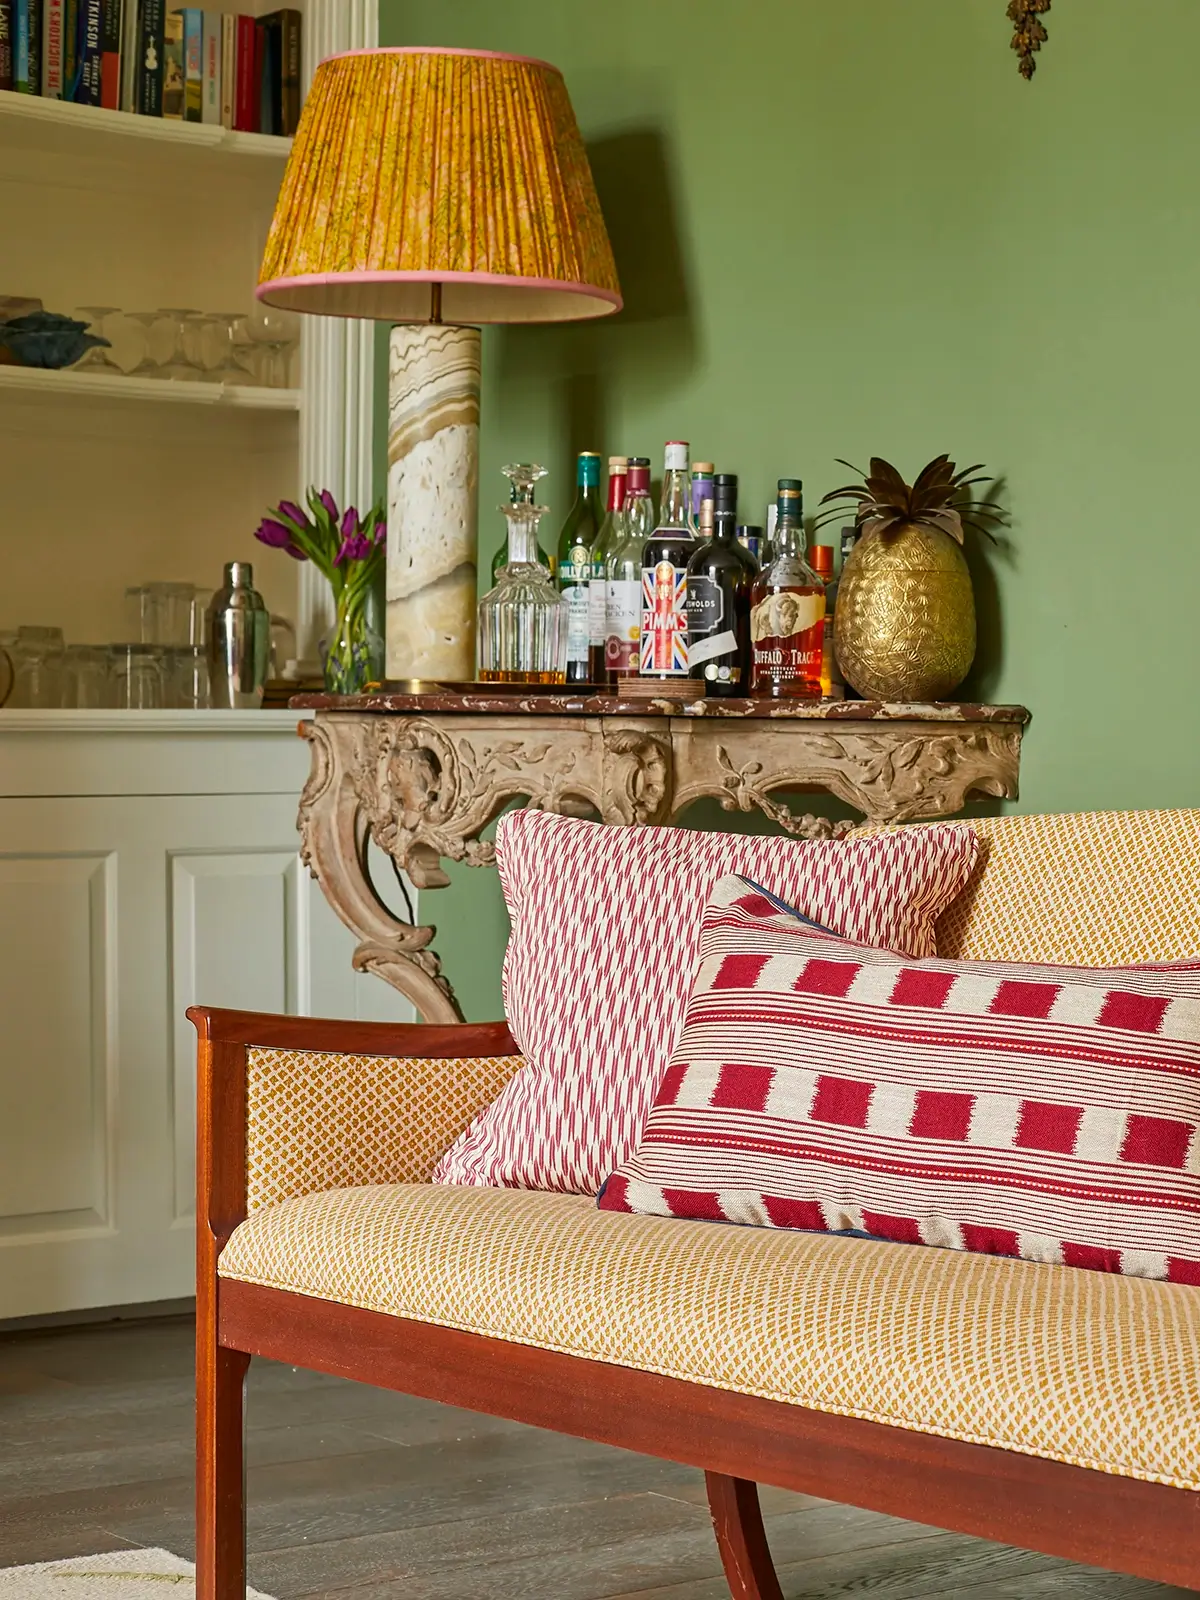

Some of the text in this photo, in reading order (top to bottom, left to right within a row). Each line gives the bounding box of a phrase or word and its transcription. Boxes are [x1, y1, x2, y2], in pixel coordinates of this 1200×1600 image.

[86, 0, 100, 49] TKINSON
[144, 0, 152, 32] ONDER
[48, 11, 60, 67] DICTATOR'S
[48, 69, 59, 88] THE
[754, 648, 815, 665] BUFFALO TRACE
